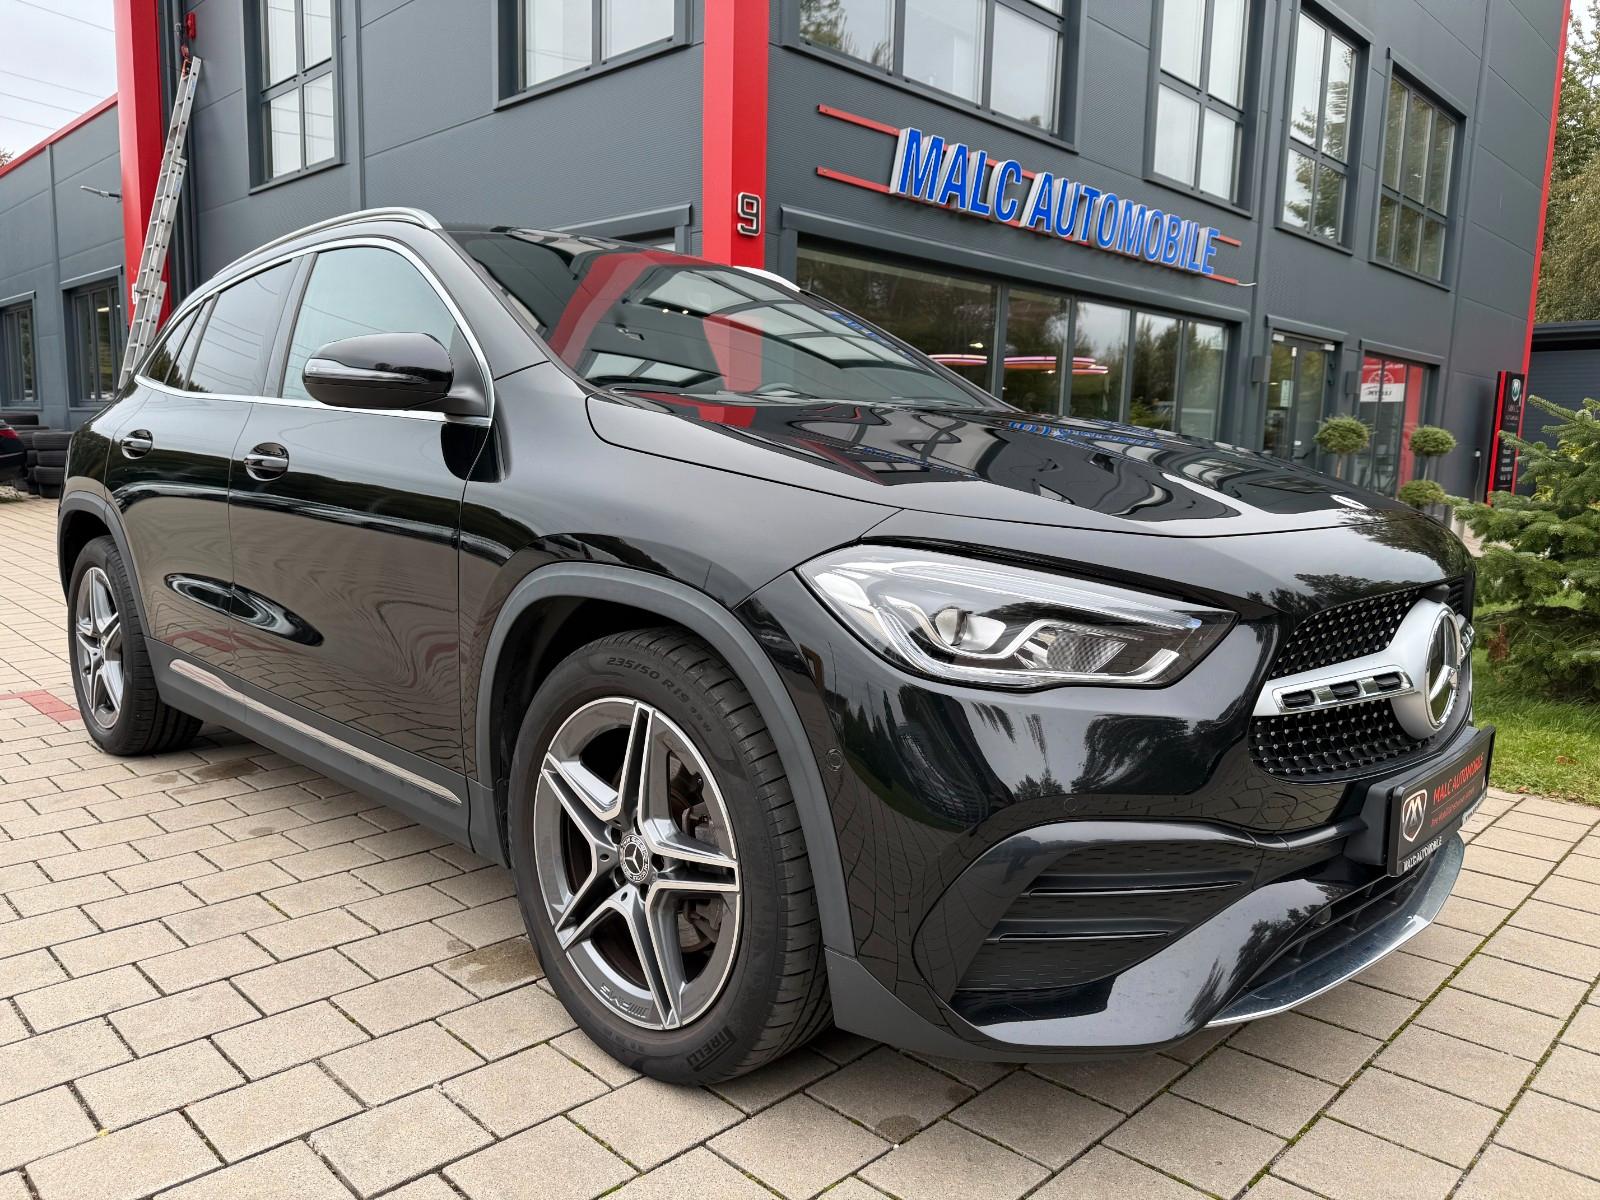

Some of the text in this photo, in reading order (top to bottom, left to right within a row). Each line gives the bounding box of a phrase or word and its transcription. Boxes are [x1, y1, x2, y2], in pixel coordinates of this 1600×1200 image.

[737, 191, 762, 237] 9
[893, 127, 1221, 275] MALC AUTOMOBILE
[606, 656, 660, 680] 235/50
[661, 678, 690, 704] R19
[686, 1025, 736, 1073] PIRELLI
